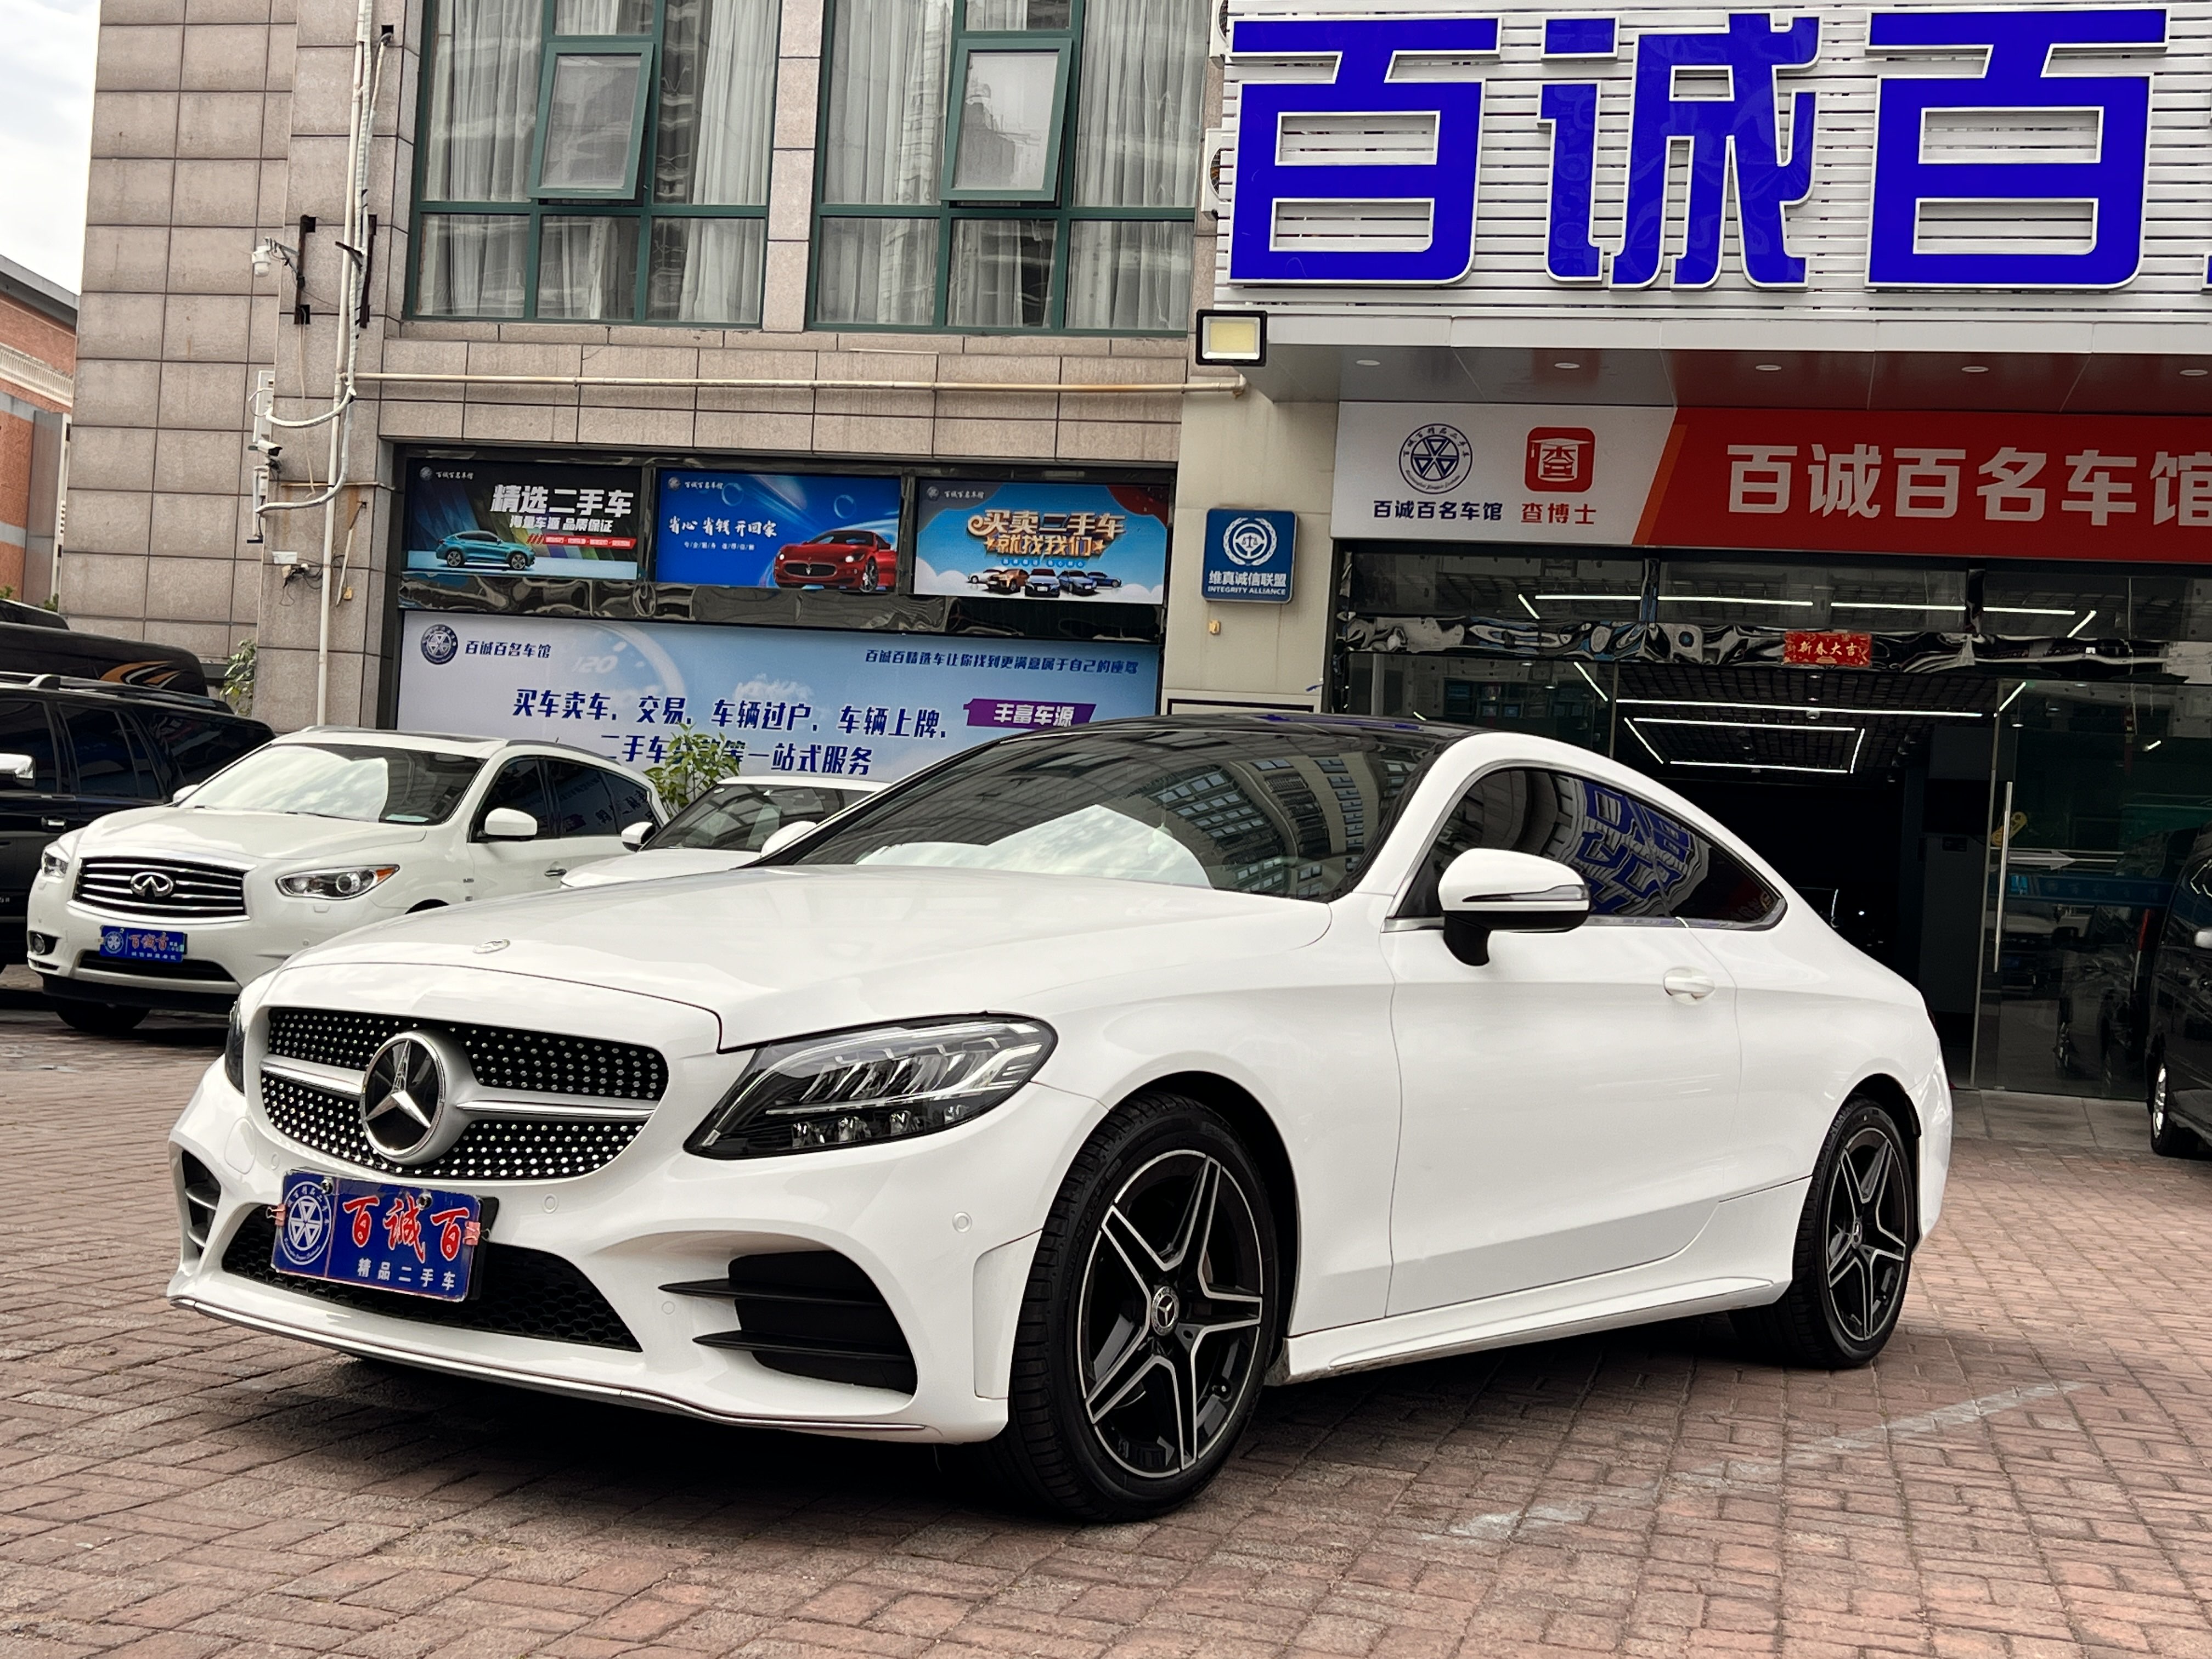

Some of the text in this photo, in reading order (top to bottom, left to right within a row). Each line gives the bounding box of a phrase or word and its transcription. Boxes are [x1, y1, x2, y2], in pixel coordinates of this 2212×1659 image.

[1229, 9, 2212, 291] 百诚百
[1726, 443, 2212, 527] 百诚百名车馆
[490, 483, 634, 518] 精选二手车
[1373, 500, 1596, 524] 百诚百名车馆 查博士
[562, 517, 613, 533] 品质保证
[668, 515, 777, 538] 省心 省钱 开回家
[968, 509, 1126, 540] 买卖二手车
[997, 534, 1093, 556] 就找我们
[1208, 569, 1286, 587] 维真诚信联盟
[1249, 587, 1285, 595] ALLIANCE
[465, 640, 551, 658] 百诚百名车馆
[1798, 641, 1858, 656] 新春大吉
[994, 703, 1075, 727] 丰富车源
[601, 735, 873, 776] 二手车等一站式服务
[358, 1257, 457, 1291] 精品二手车
